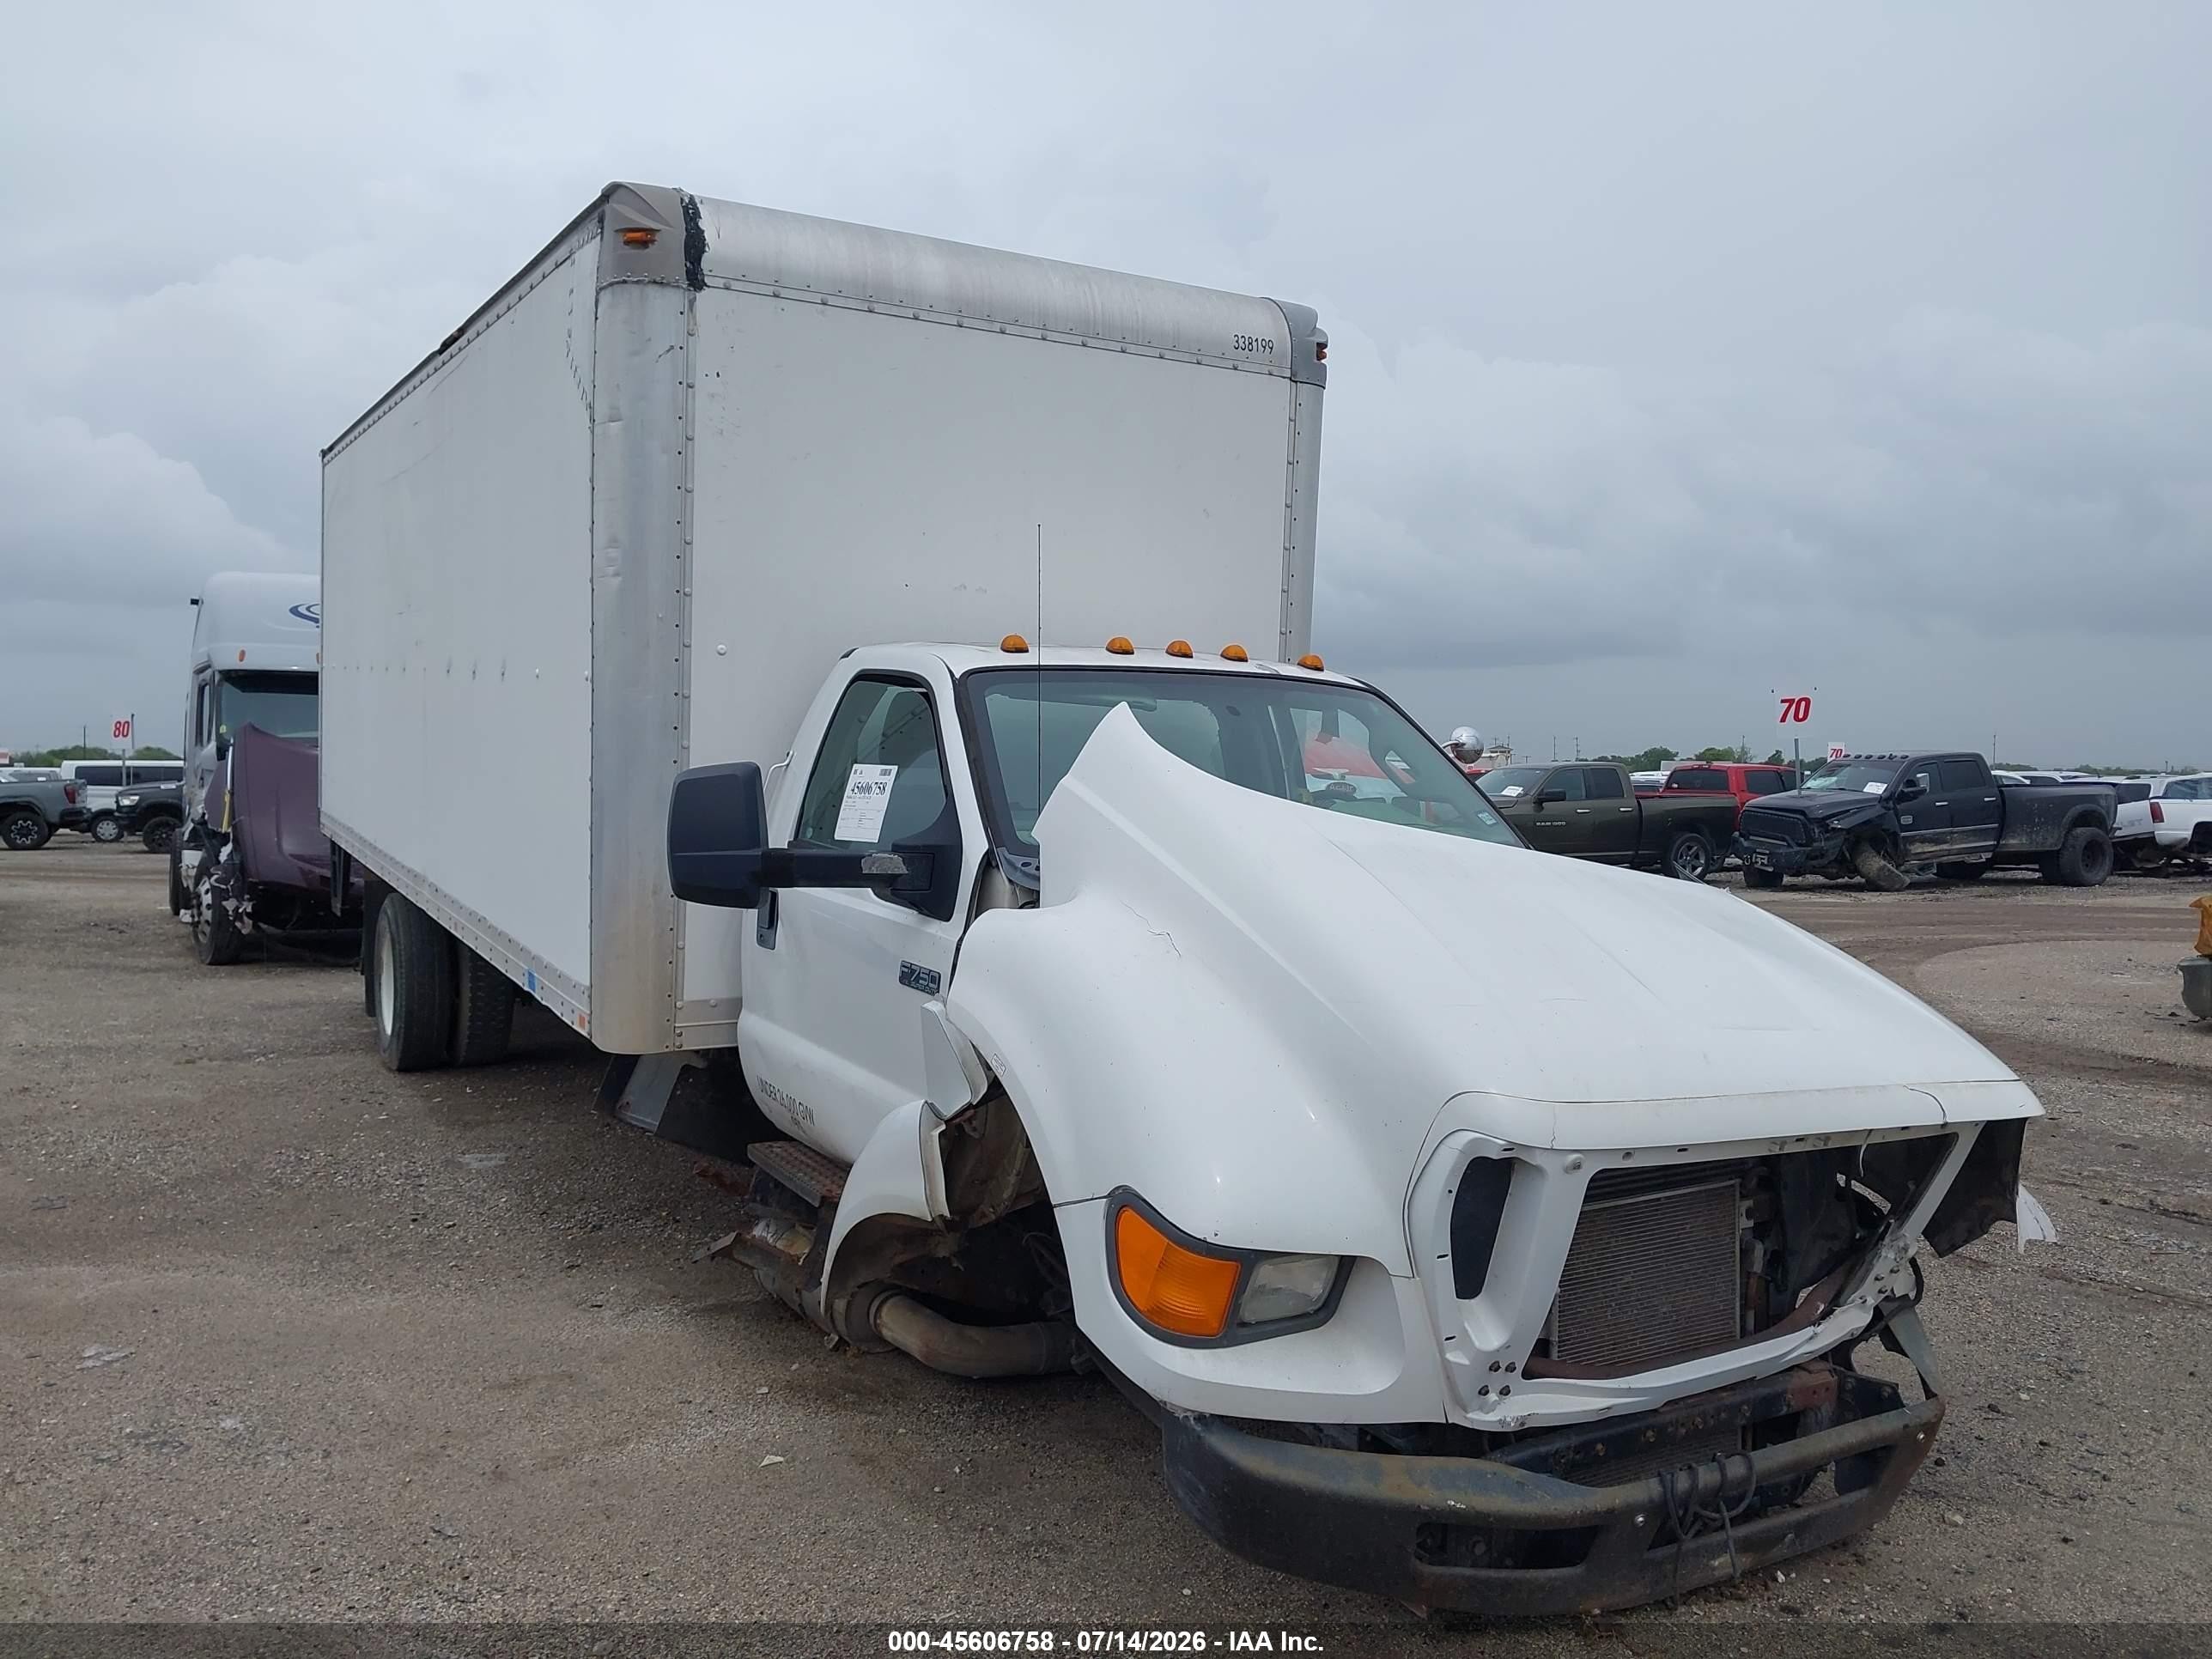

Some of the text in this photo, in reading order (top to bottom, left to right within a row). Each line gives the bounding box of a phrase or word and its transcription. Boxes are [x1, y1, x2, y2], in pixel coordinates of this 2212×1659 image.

[1233, 334, 1274, 355] 338199
[1779, 696, 1811, 723] 70
[113, 720, 130, 738] 80
[1830, 748, 1843, 759] 70
[851, 781, 888, 796] 45606758
